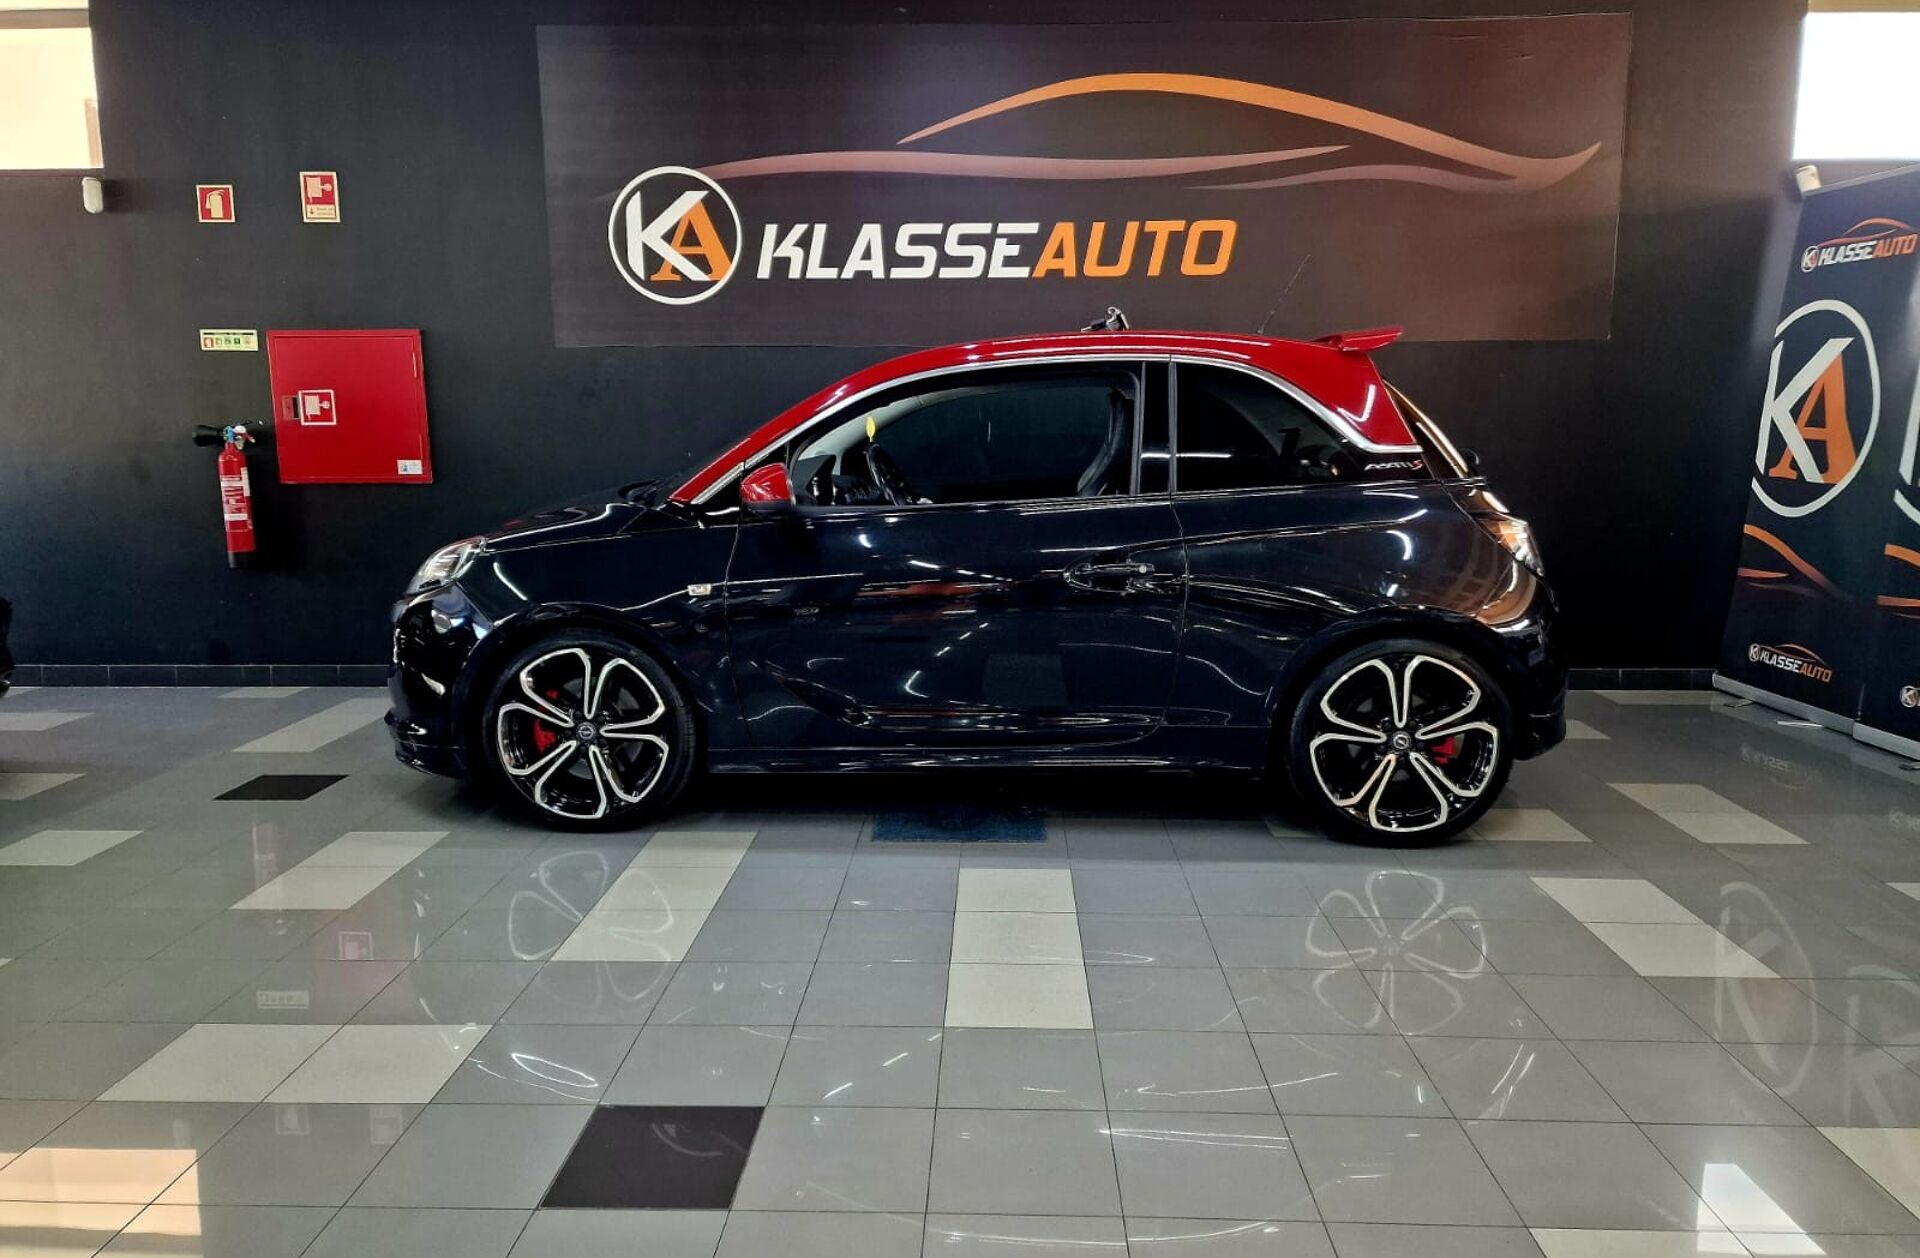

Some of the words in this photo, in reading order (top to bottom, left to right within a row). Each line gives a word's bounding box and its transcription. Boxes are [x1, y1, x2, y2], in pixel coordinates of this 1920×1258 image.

[756, 219, 1238, 280] KLASSEAUTO
[1818, 233, 1918, 267] KLASSEAUTO
[1755, 336, 1857, 485] KA
[1760, 649, 1832, 682] KLASSEAUTO
